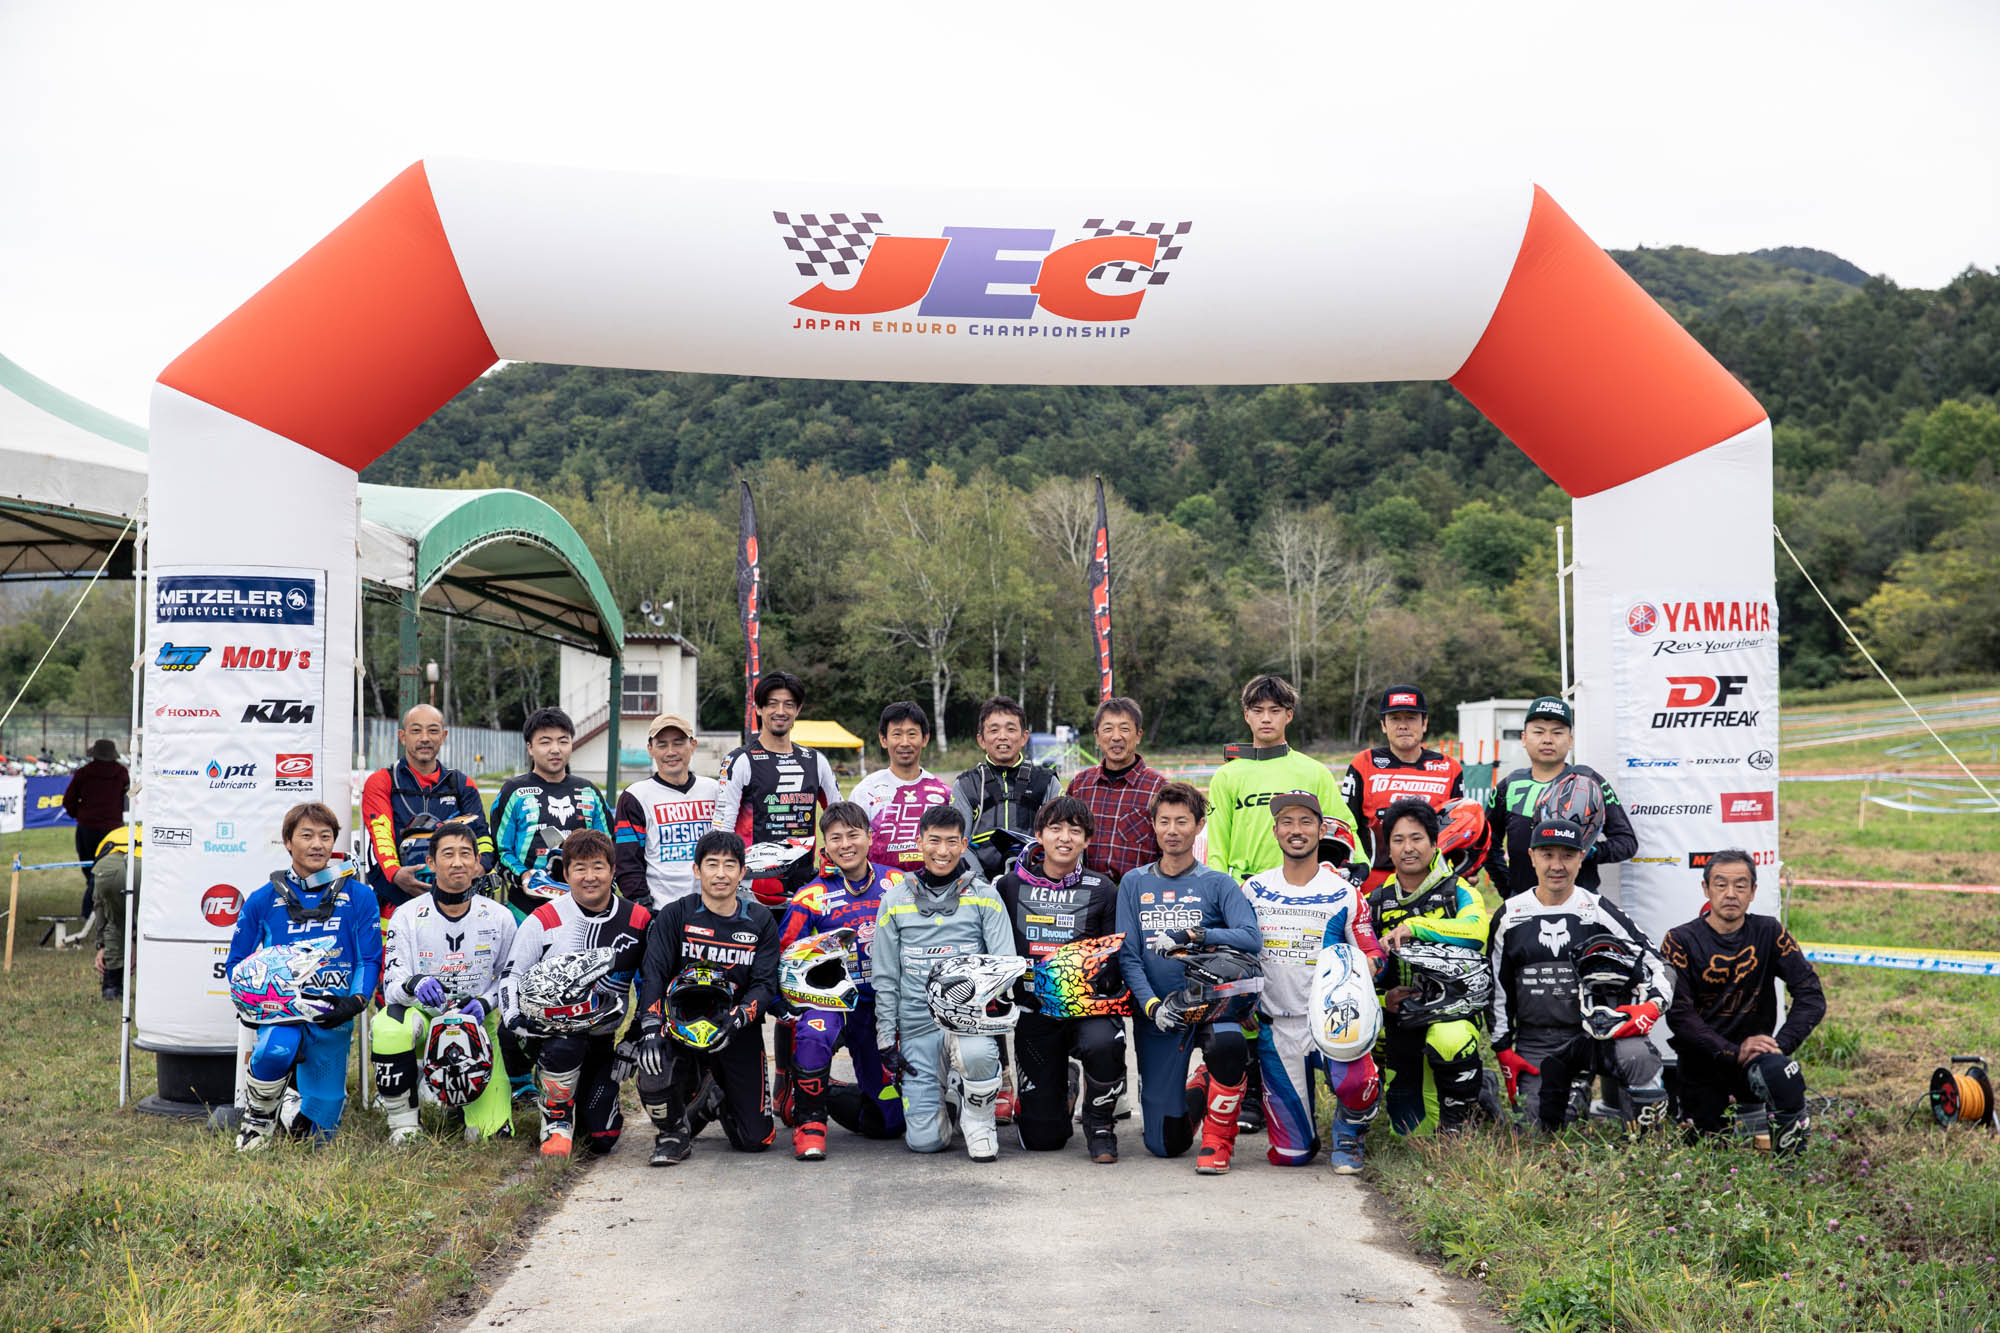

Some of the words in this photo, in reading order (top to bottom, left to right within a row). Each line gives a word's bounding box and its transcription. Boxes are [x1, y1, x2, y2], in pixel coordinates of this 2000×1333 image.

[788, 226, 1159, 321] JEC
[793, 318, 860, 332] JAPAN
[873, 321, 958, 335] ENDURO
[968, 324, 1131, 338] CHAMPIONSHIP
[159, 589, 282, 605] METZELER
[159, 607, 235, 617] MOTORCYCLE
[243, 607, 283, 618] TYRES
[1662, 601, 1770, 632] YAMAHA
[1652, 639, 1702, 657] Revs
[1704, 640, 1738, 654] Your
[221, 646, 312, 672] Moty's
[1665, 676, 1748, 708] DF
[167, 708, 221, 718] HONDA
[240, 699, 315, 724] KTM
[1651, 711, 1760, 728] DIRTFREAK
[1626, 758, 1680, 768] Technix
[1695, 757, 1741, 765] DUNLOP
[223, 763, 257, 779] ptt
[209, 780, 257, 789] Lubricants
[1388, 780, 1447, 795] ENDURO
[656, 802, 695, 822] TROY
[1630, 804, 1713, 815] BRIDGESTONE
[1030, 887, 1077, 904] KENNY
[202, 897, 244, 915] MFJ
[1140, 910, 1201, 921] CROSS
[287, 916, 342, 934] DFG
[1142, 919, 1199, 929] MISSION
[681, 942, 706, 960] FLY
[1269, 949, 1308, 959] NOCO
[955, 1017, 975, 1025] Arai
